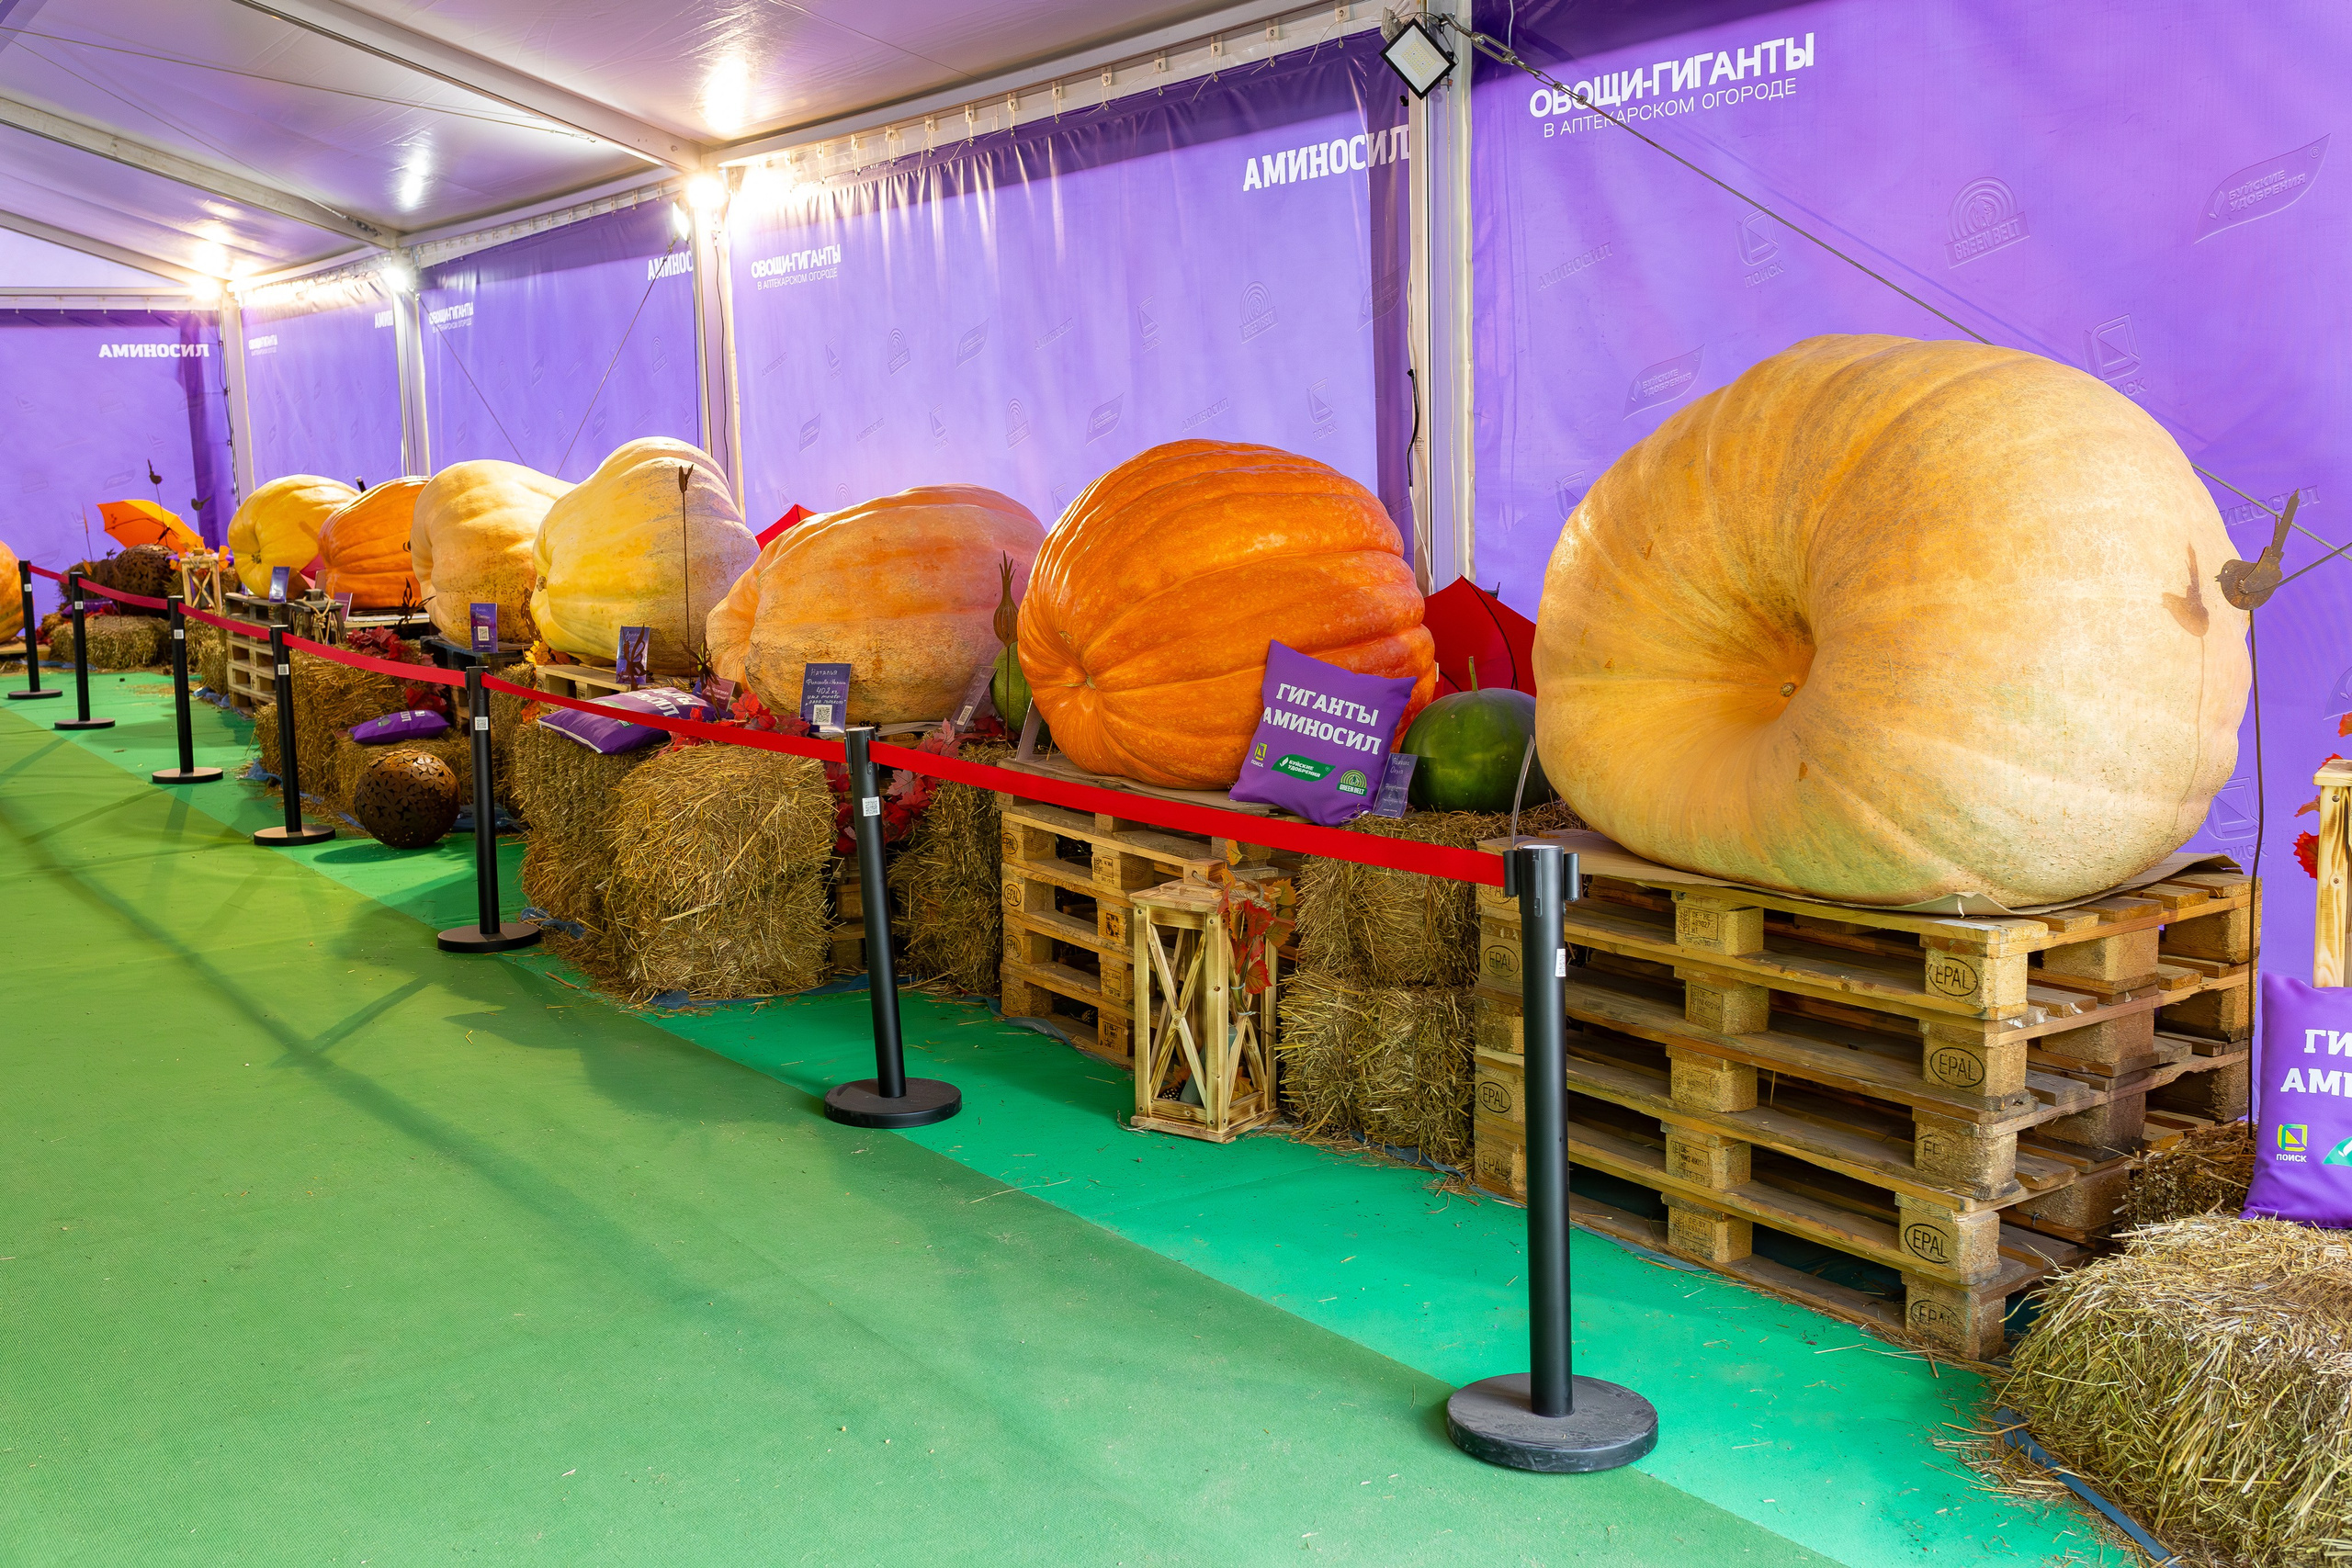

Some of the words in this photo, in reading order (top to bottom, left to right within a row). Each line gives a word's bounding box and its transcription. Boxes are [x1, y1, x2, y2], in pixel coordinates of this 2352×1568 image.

[1529, 32, 1815, 118] ОВОЩИ-ГИГАНТЫ
[1544, 123, 1555, 138] В
[1560, 96, 1695, 136] АПТЕКАРСКОМ
[1702, 77, 1796, 109] ОГОРОДЕ
[1243, 124, 1409, 192] АМИНОСИЛ
[2228, 169, 2286, 201] БУЙСКИЕ
[2230, 173, 2307, 213] УДОБРЕНИЯ
[1953, 231, 1992, 262] GREEN
[1991, 218, 2020, 248] BELT
[751, 243, 842, 278] ОВОЩИ-ГИГАНТЫ
[1537, 242, 1613, 292] АМИНОСИЛ
[1744, 260, 1785, 288] ПОИСК
[763, 273, 808, 290] АПТЕКАРСКОМ
[808, 267, 838, 282] ОГОРОДЕ
[98, 344, 209, 358] АМИНОСИЛ
[1276, 683, 1379, 727] ГИГАНТЫ
[1263, 706, 1382, 755] АМИНОСИЛ
[1250, 759, 1264, 768] ПОИСК
[1287, 764, 1321, 778] УДОБРЕНИЯ
[1288, 760, 1315, 771] БУЙСКИЕ
[1339, 784, 1353, 793] GREEN
[1352, 786, 1365, 795] BELT
[1489, 951, 1514, 972] EPAL
[1936, 965, 1971, 990] EPAL
[1939, 1054, 1976, 1081] EPAL
[1482, 1088, 1507, 1111] EPAL
[2276, 1154, 2307, 1163] ПОИСК
[1913, 1229, 1948, 1258] EPAL
